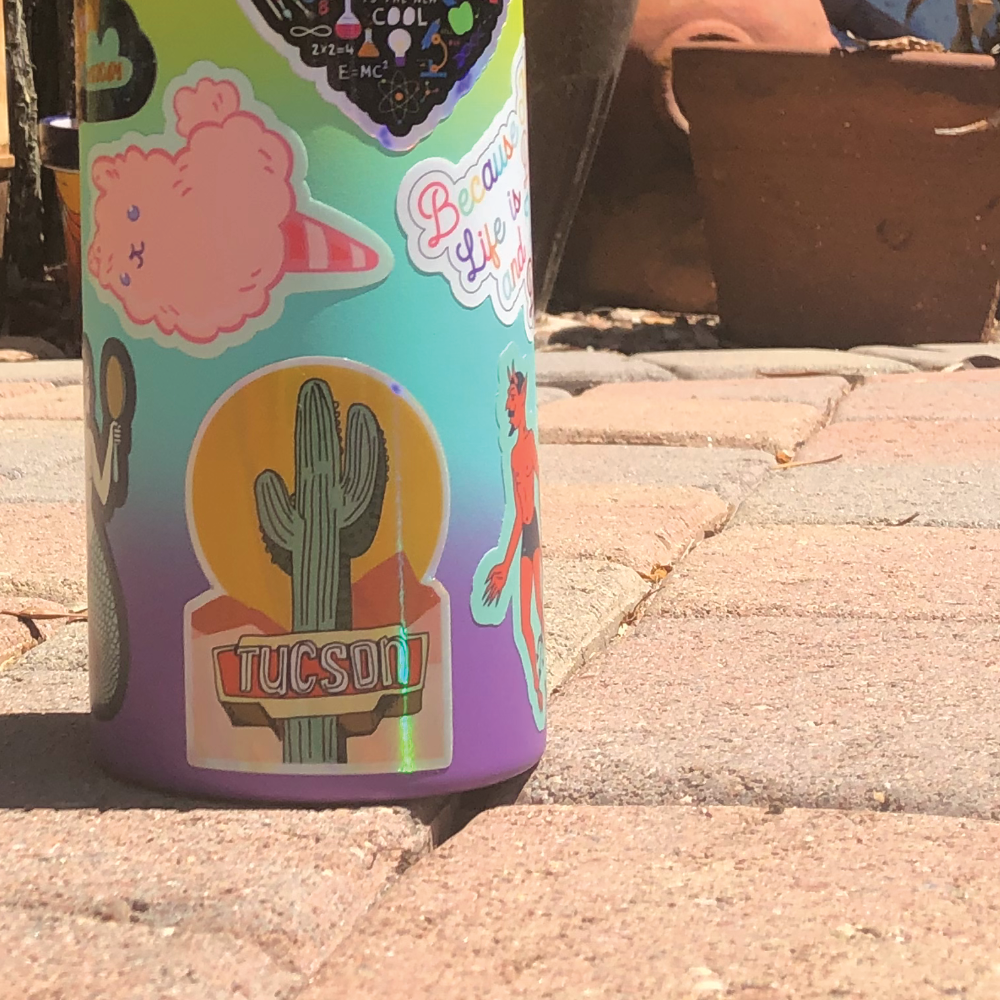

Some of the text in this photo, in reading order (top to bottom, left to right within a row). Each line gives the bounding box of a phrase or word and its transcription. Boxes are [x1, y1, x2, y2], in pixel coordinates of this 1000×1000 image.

[372, 6, 428, 26] COOL
[418, 121, 519, 248] Because
[456, 189, 521, 282] Life is
[503, 226, 526, 300] and
